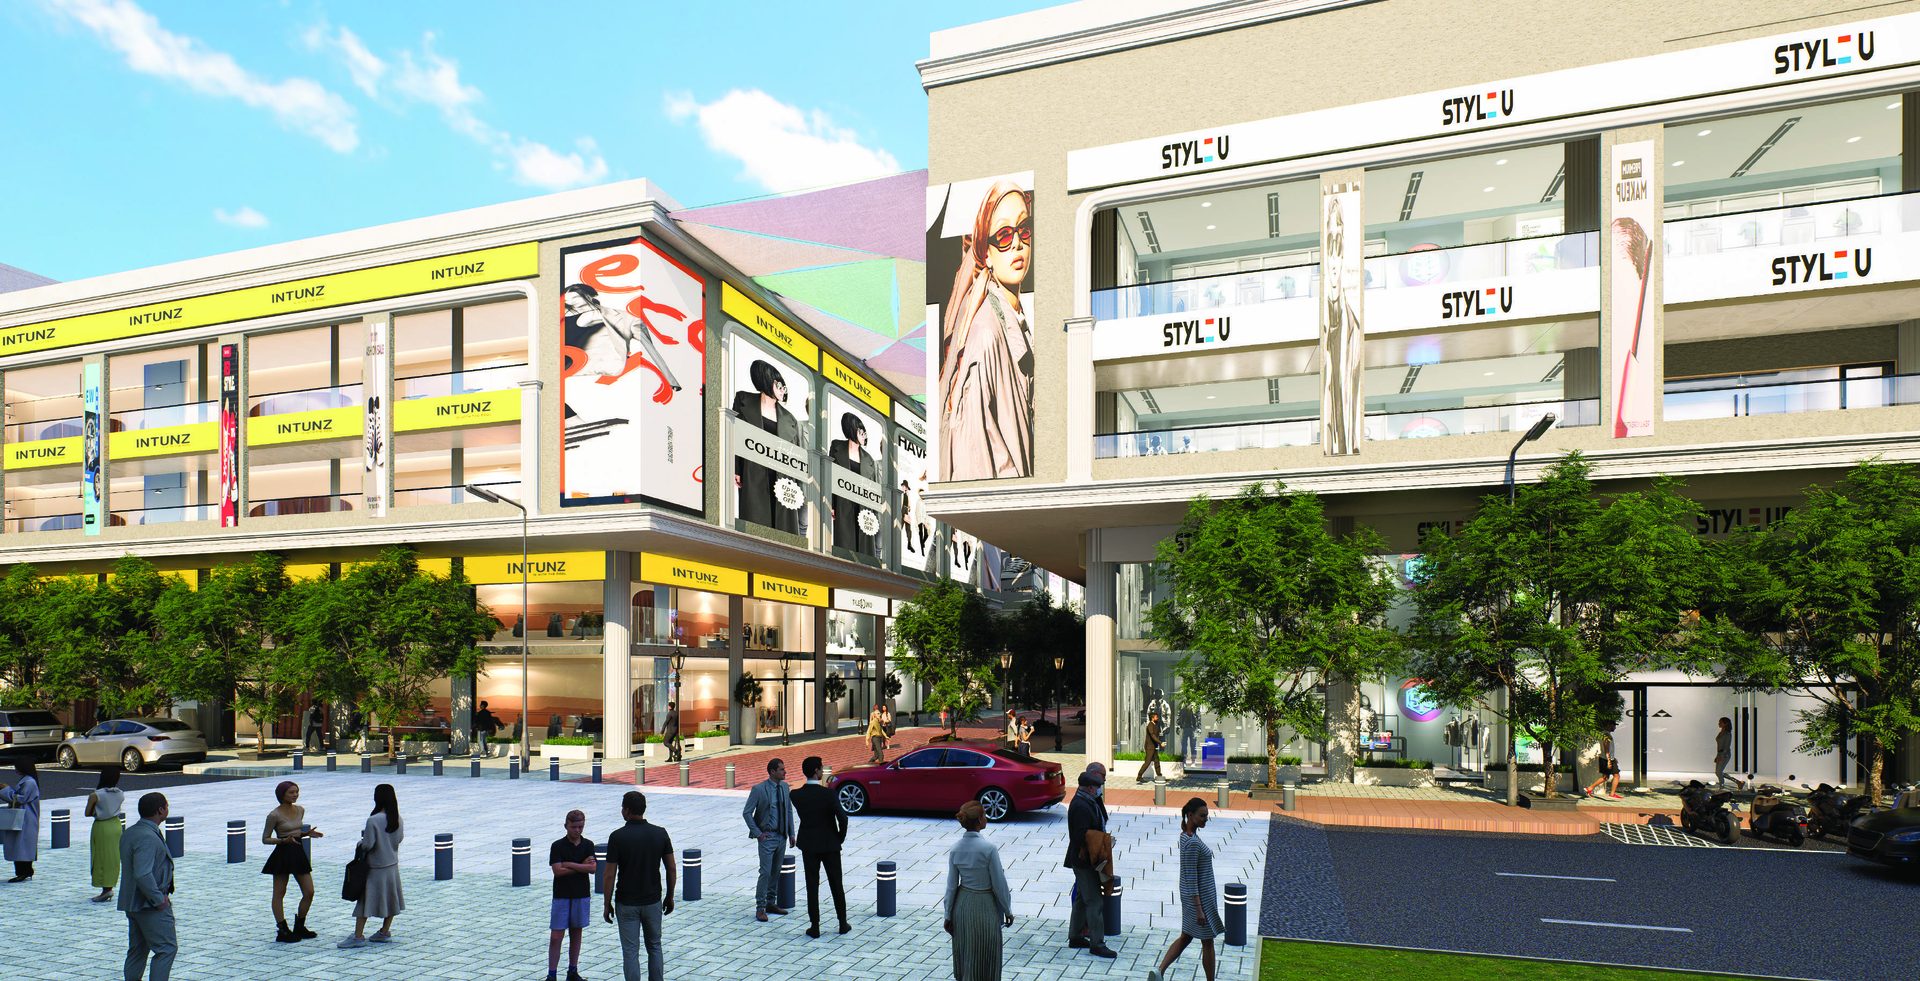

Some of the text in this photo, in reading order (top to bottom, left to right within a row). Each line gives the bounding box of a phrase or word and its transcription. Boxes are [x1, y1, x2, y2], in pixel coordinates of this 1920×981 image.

[430, 261, 486, 280] INTUNZ
[271, 285, 325, 304] INTUNZ
[129, 307, 183, 326] INTUNZ
[2, 328, 56, 346] INTUNZ
[756, 315, 793, 346] INTUNZ
[835, 367, 872, 398] INTUNZ
[436, 401, 491, 416] INTUNZ
[278, 419, 333, 434] INTUNZ
[136, 433, 190, 448] INTUNZ
[16, 446, 66, 459] INTUNZ
[507, 561, 566, 575] INTUNZ
[673, 567, 719, 584] INTUNZ
[762, 580, 808, 597] INTUNZ
